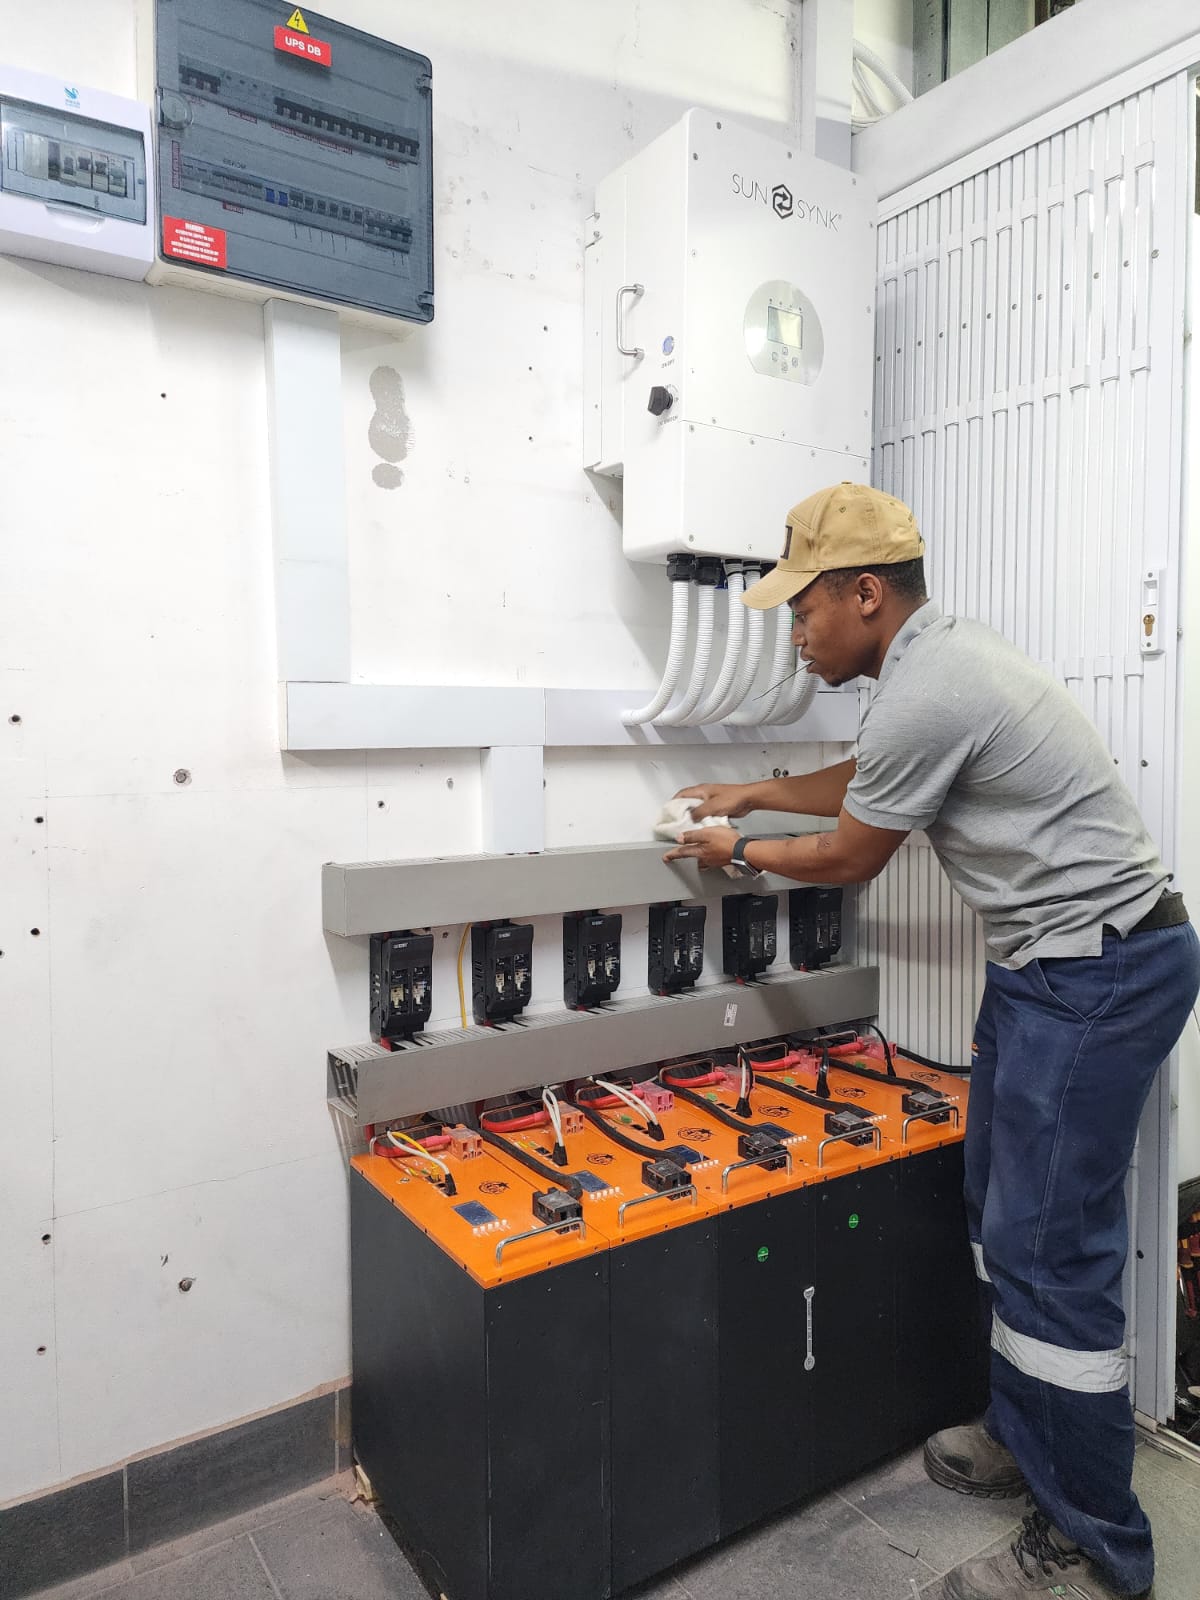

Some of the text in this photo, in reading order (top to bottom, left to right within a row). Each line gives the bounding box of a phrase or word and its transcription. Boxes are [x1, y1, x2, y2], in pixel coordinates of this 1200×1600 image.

[285, 36, 321, 56] UPS DB
[732, 173, 767, 204] SUN
